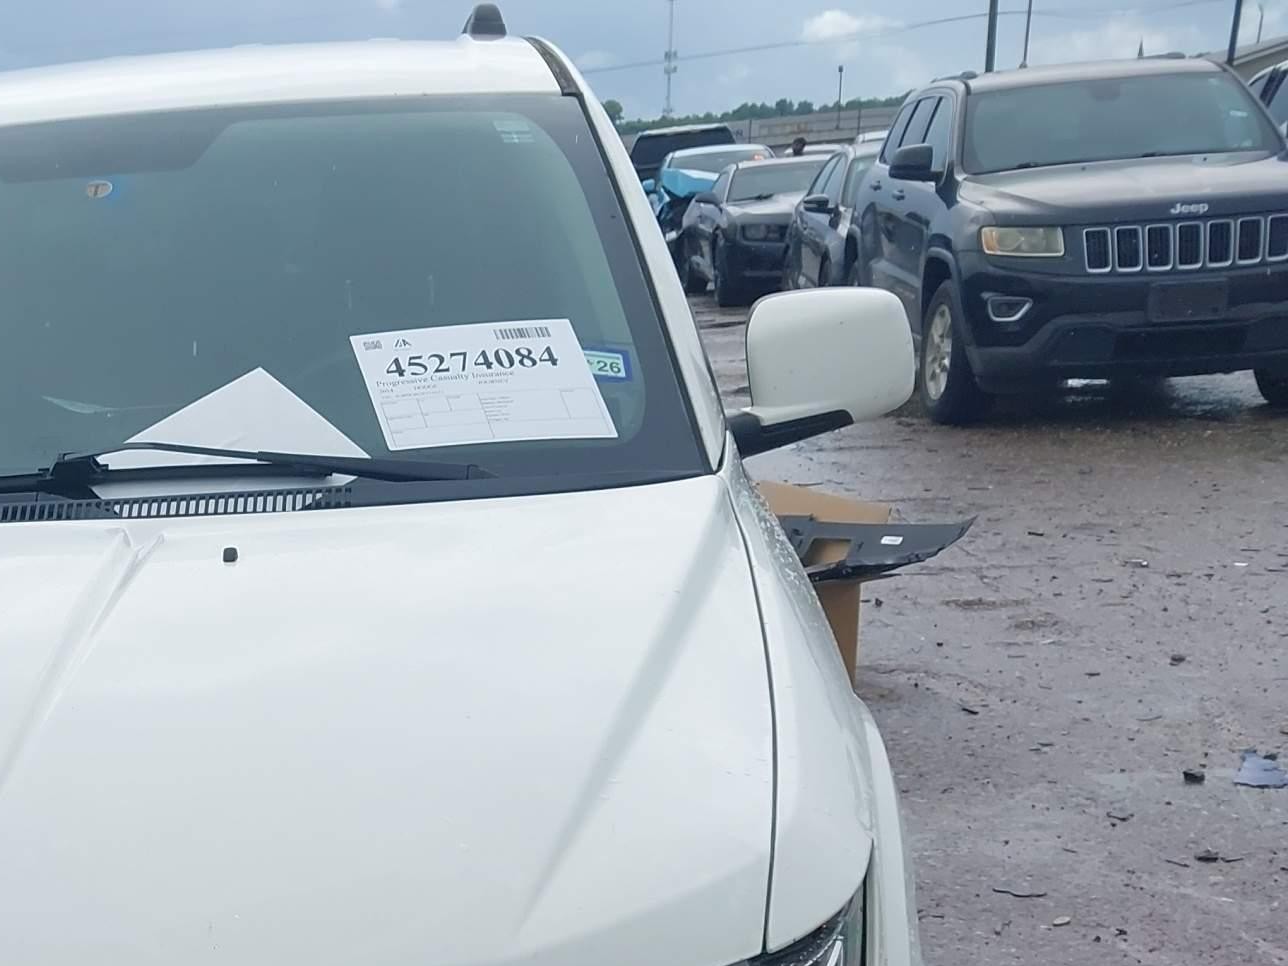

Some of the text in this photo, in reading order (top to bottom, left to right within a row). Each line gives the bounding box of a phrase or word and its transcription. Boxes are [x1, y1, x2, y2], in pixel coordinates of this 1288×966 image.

[1170, 203, 1209, 214] Jeep
[386, 345, 559, 378] 45274084
[596, 360, 622, 374] 26
[376, 370, 515, 389] Progressive Casualty Insurance
